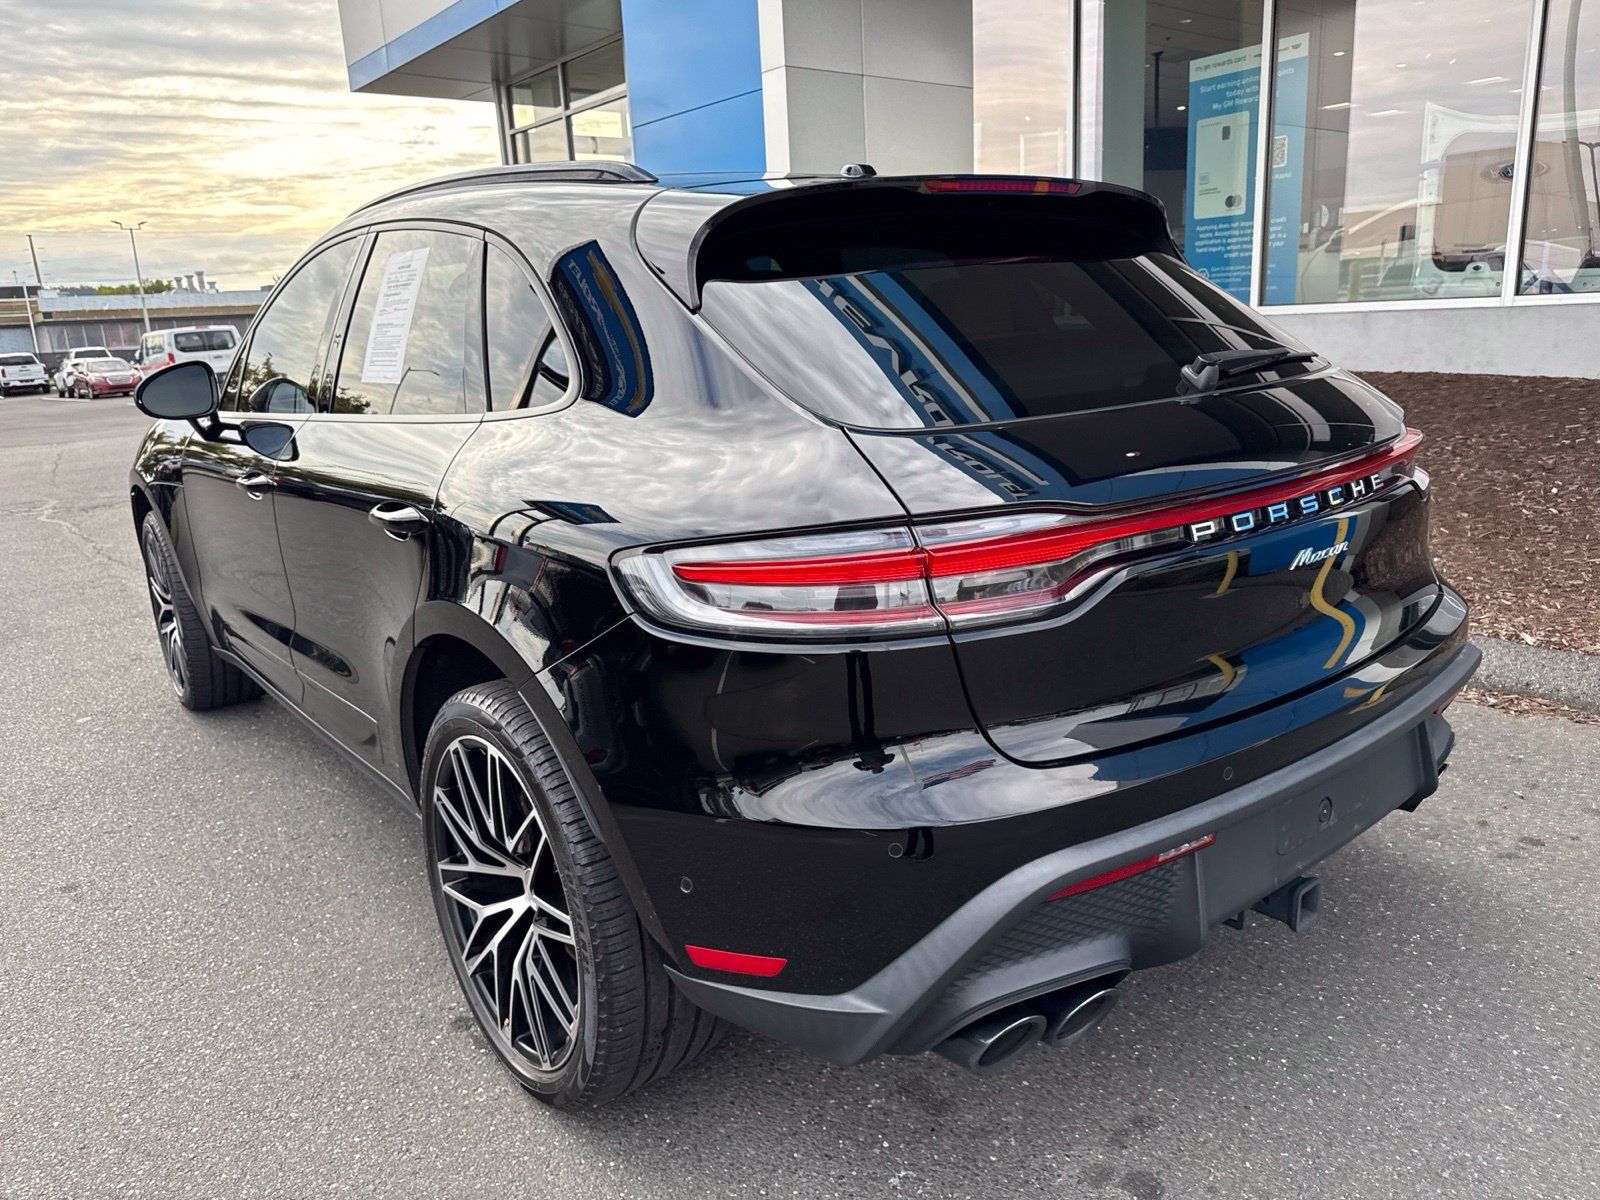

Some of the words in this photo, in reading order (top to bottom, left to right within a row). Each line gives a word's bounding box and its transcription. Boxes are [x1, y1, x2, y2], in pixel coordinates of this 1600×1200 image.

[1200, 84, 1216, 93] Start
[1217, 79, 1240, 89] earning
[1226, 89, 1245, 98] today
[1190, 473, 1385, 542] PORSCHE
[1288, 540, 1349, 571] Macan
